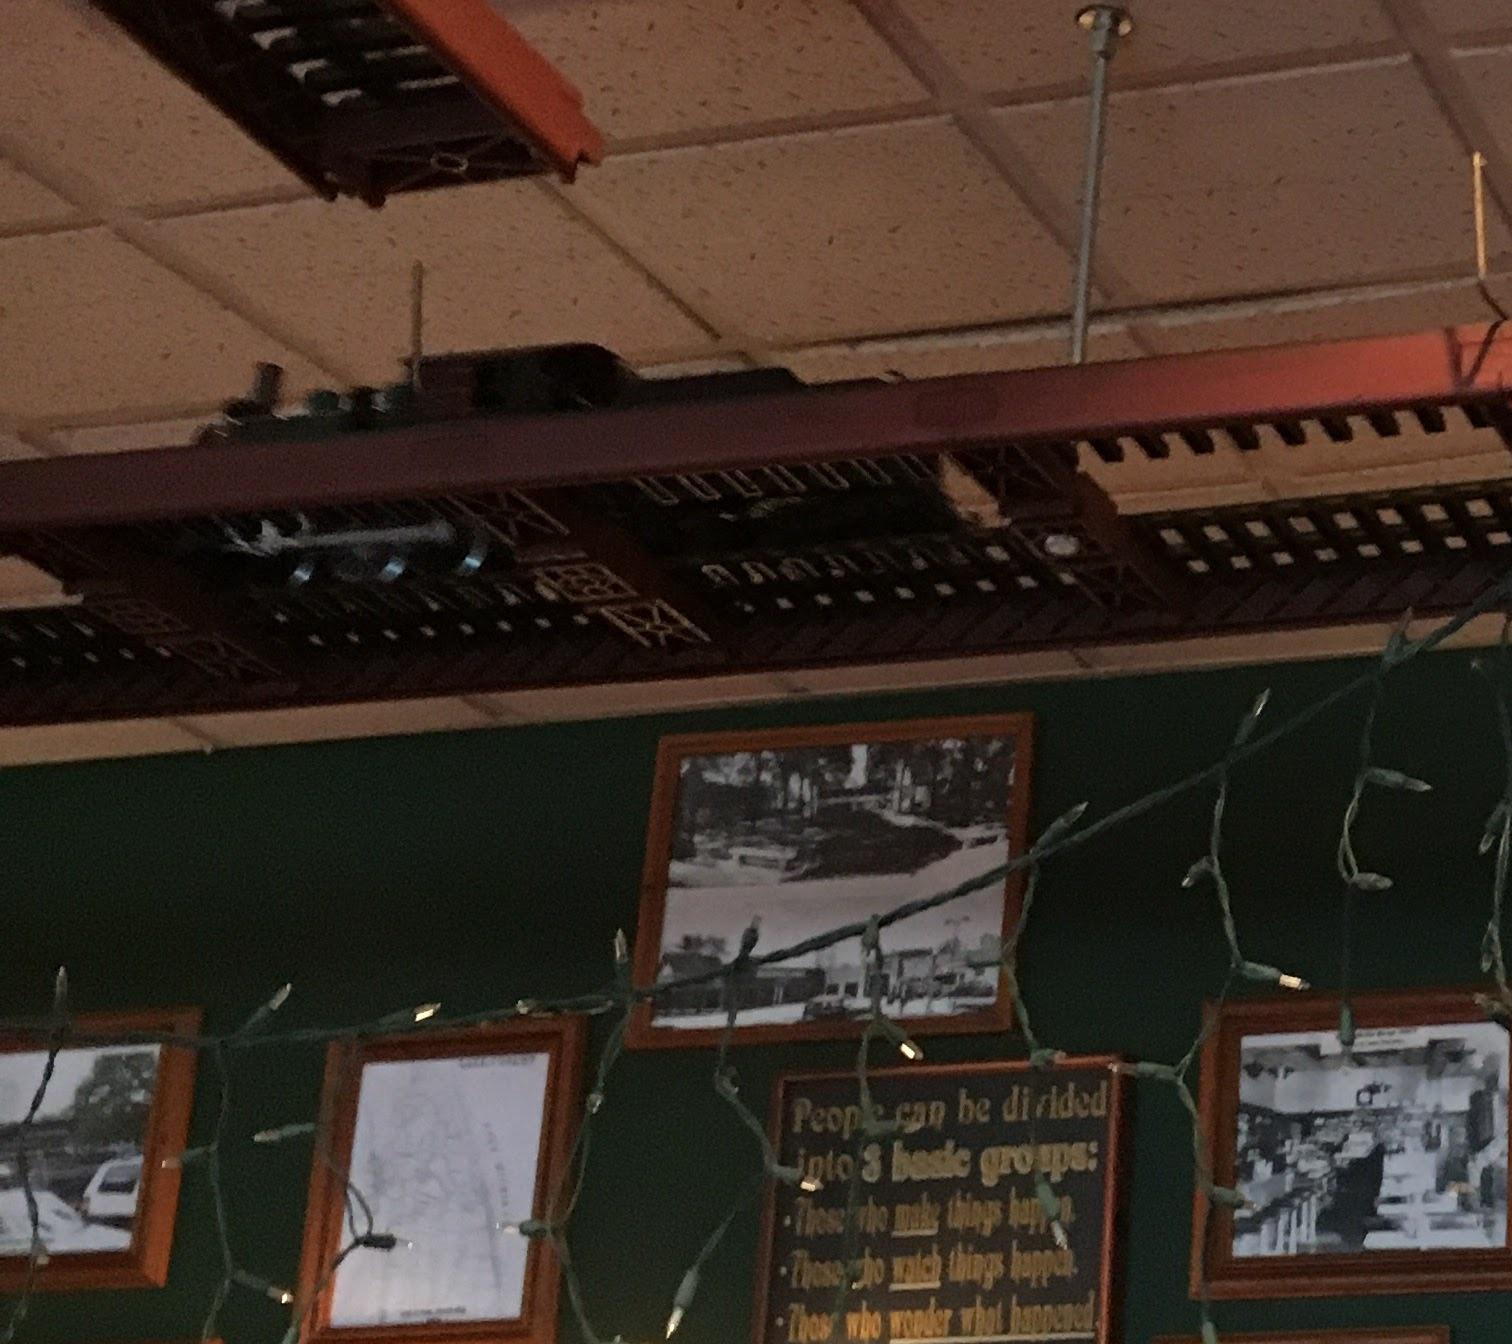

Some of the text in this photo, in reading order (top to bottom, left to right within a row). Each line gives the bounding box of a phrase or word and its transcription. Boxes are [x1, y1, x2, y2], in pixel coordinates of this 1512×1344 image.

[791, 1097, 885, 1140] Peope
[895, 1100, 946, 1134] can
[958, 1087, 991, 1124] be
[798, 1147, 854, 1183] into
[861, 1142, 882, 1184] 3
[1008, 1186, 1077, 1235] happn.
[845, 1299, 882, 1343] who
